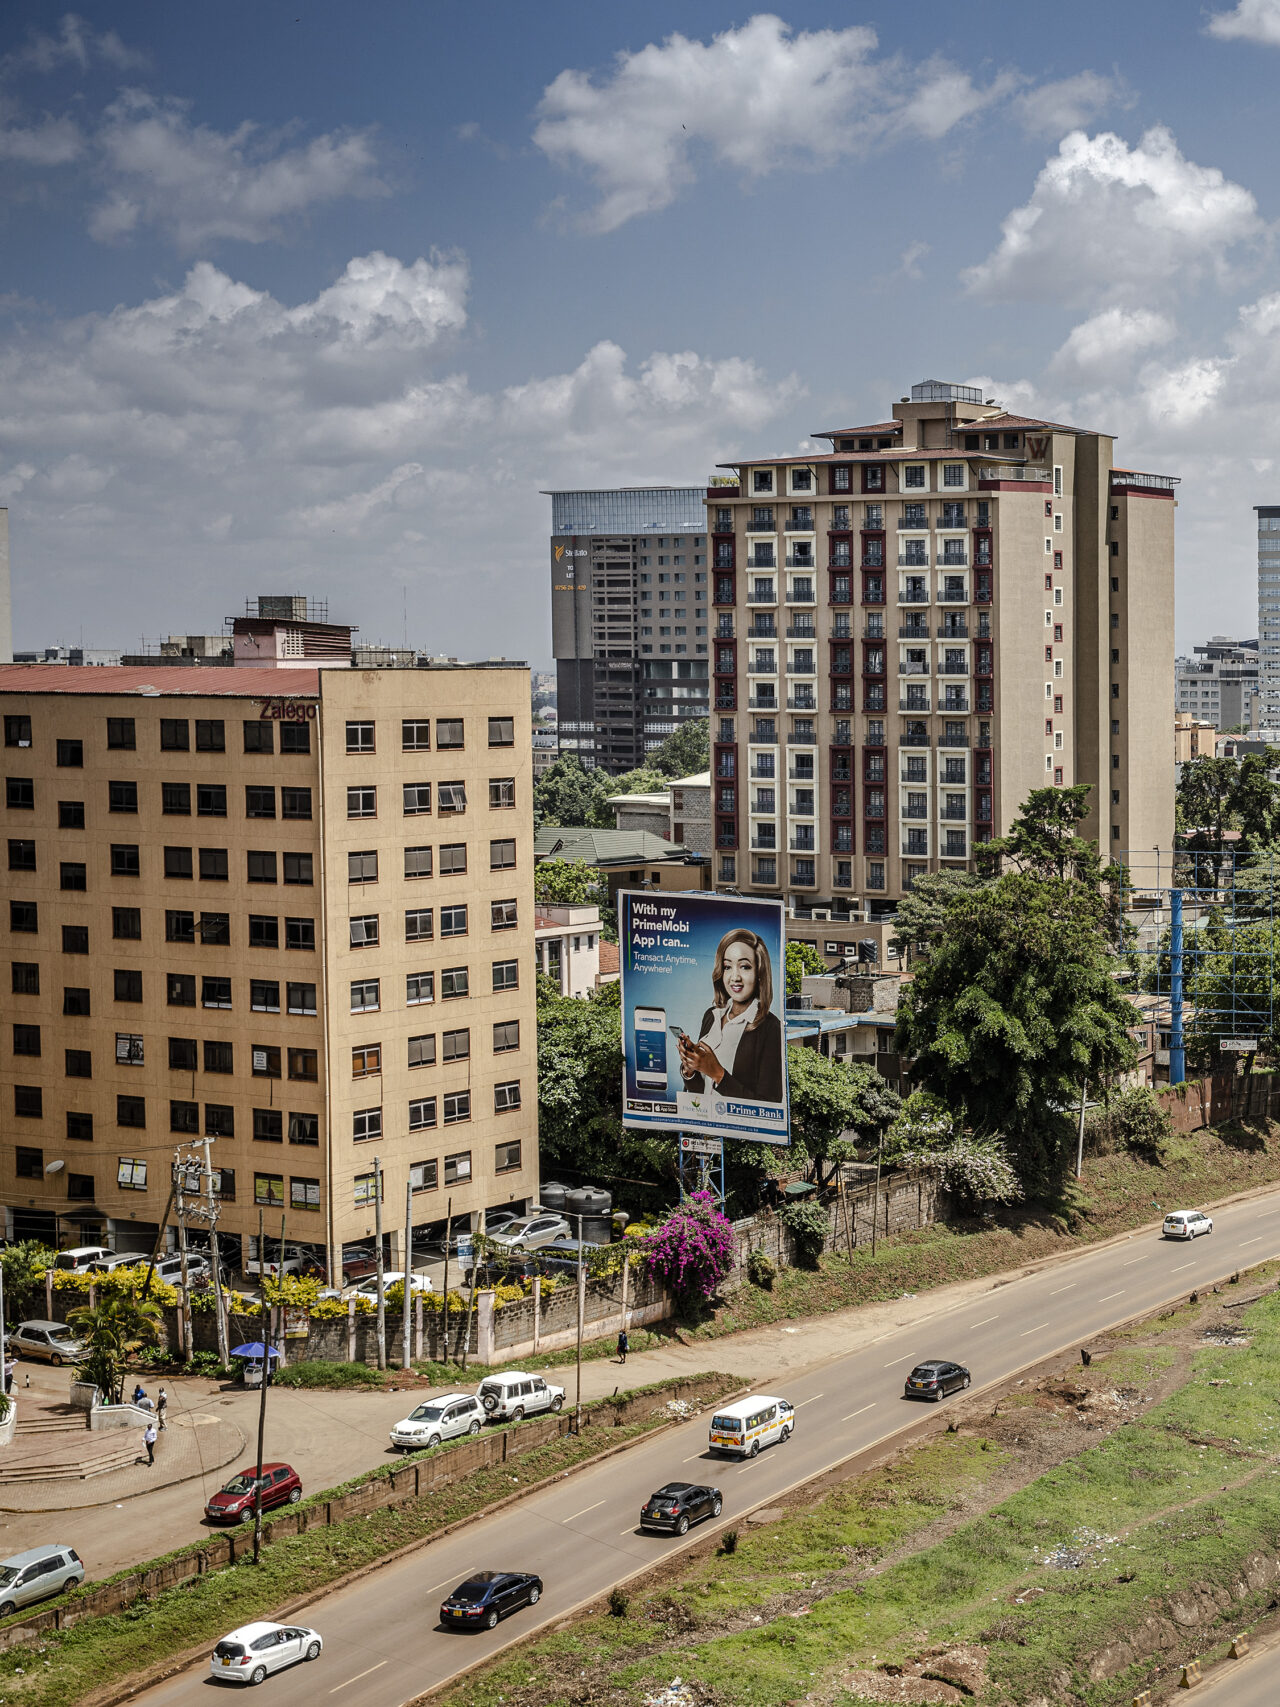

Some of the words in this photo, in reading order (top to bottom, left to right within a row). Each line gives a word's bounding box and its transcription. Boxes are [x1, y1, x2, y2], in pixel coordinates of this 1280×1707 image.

[260, 699, 317, 724] Zalego
[632, 902, 657, 915] With
[660, 907, 677, 919] my
[632, 918, 690, 933] PrimeMobi
[632, 933, 655, 948] App
[662, 938, 690, 948] can...
[633, 951, 664, 962] Transact
[665, 954, 698, 966] Anytime,
[633, 962, 673, 974] Anywhere!
[729, 1104, 757, 1116] Prime
[758, 1107, 782, 1119] Bank
